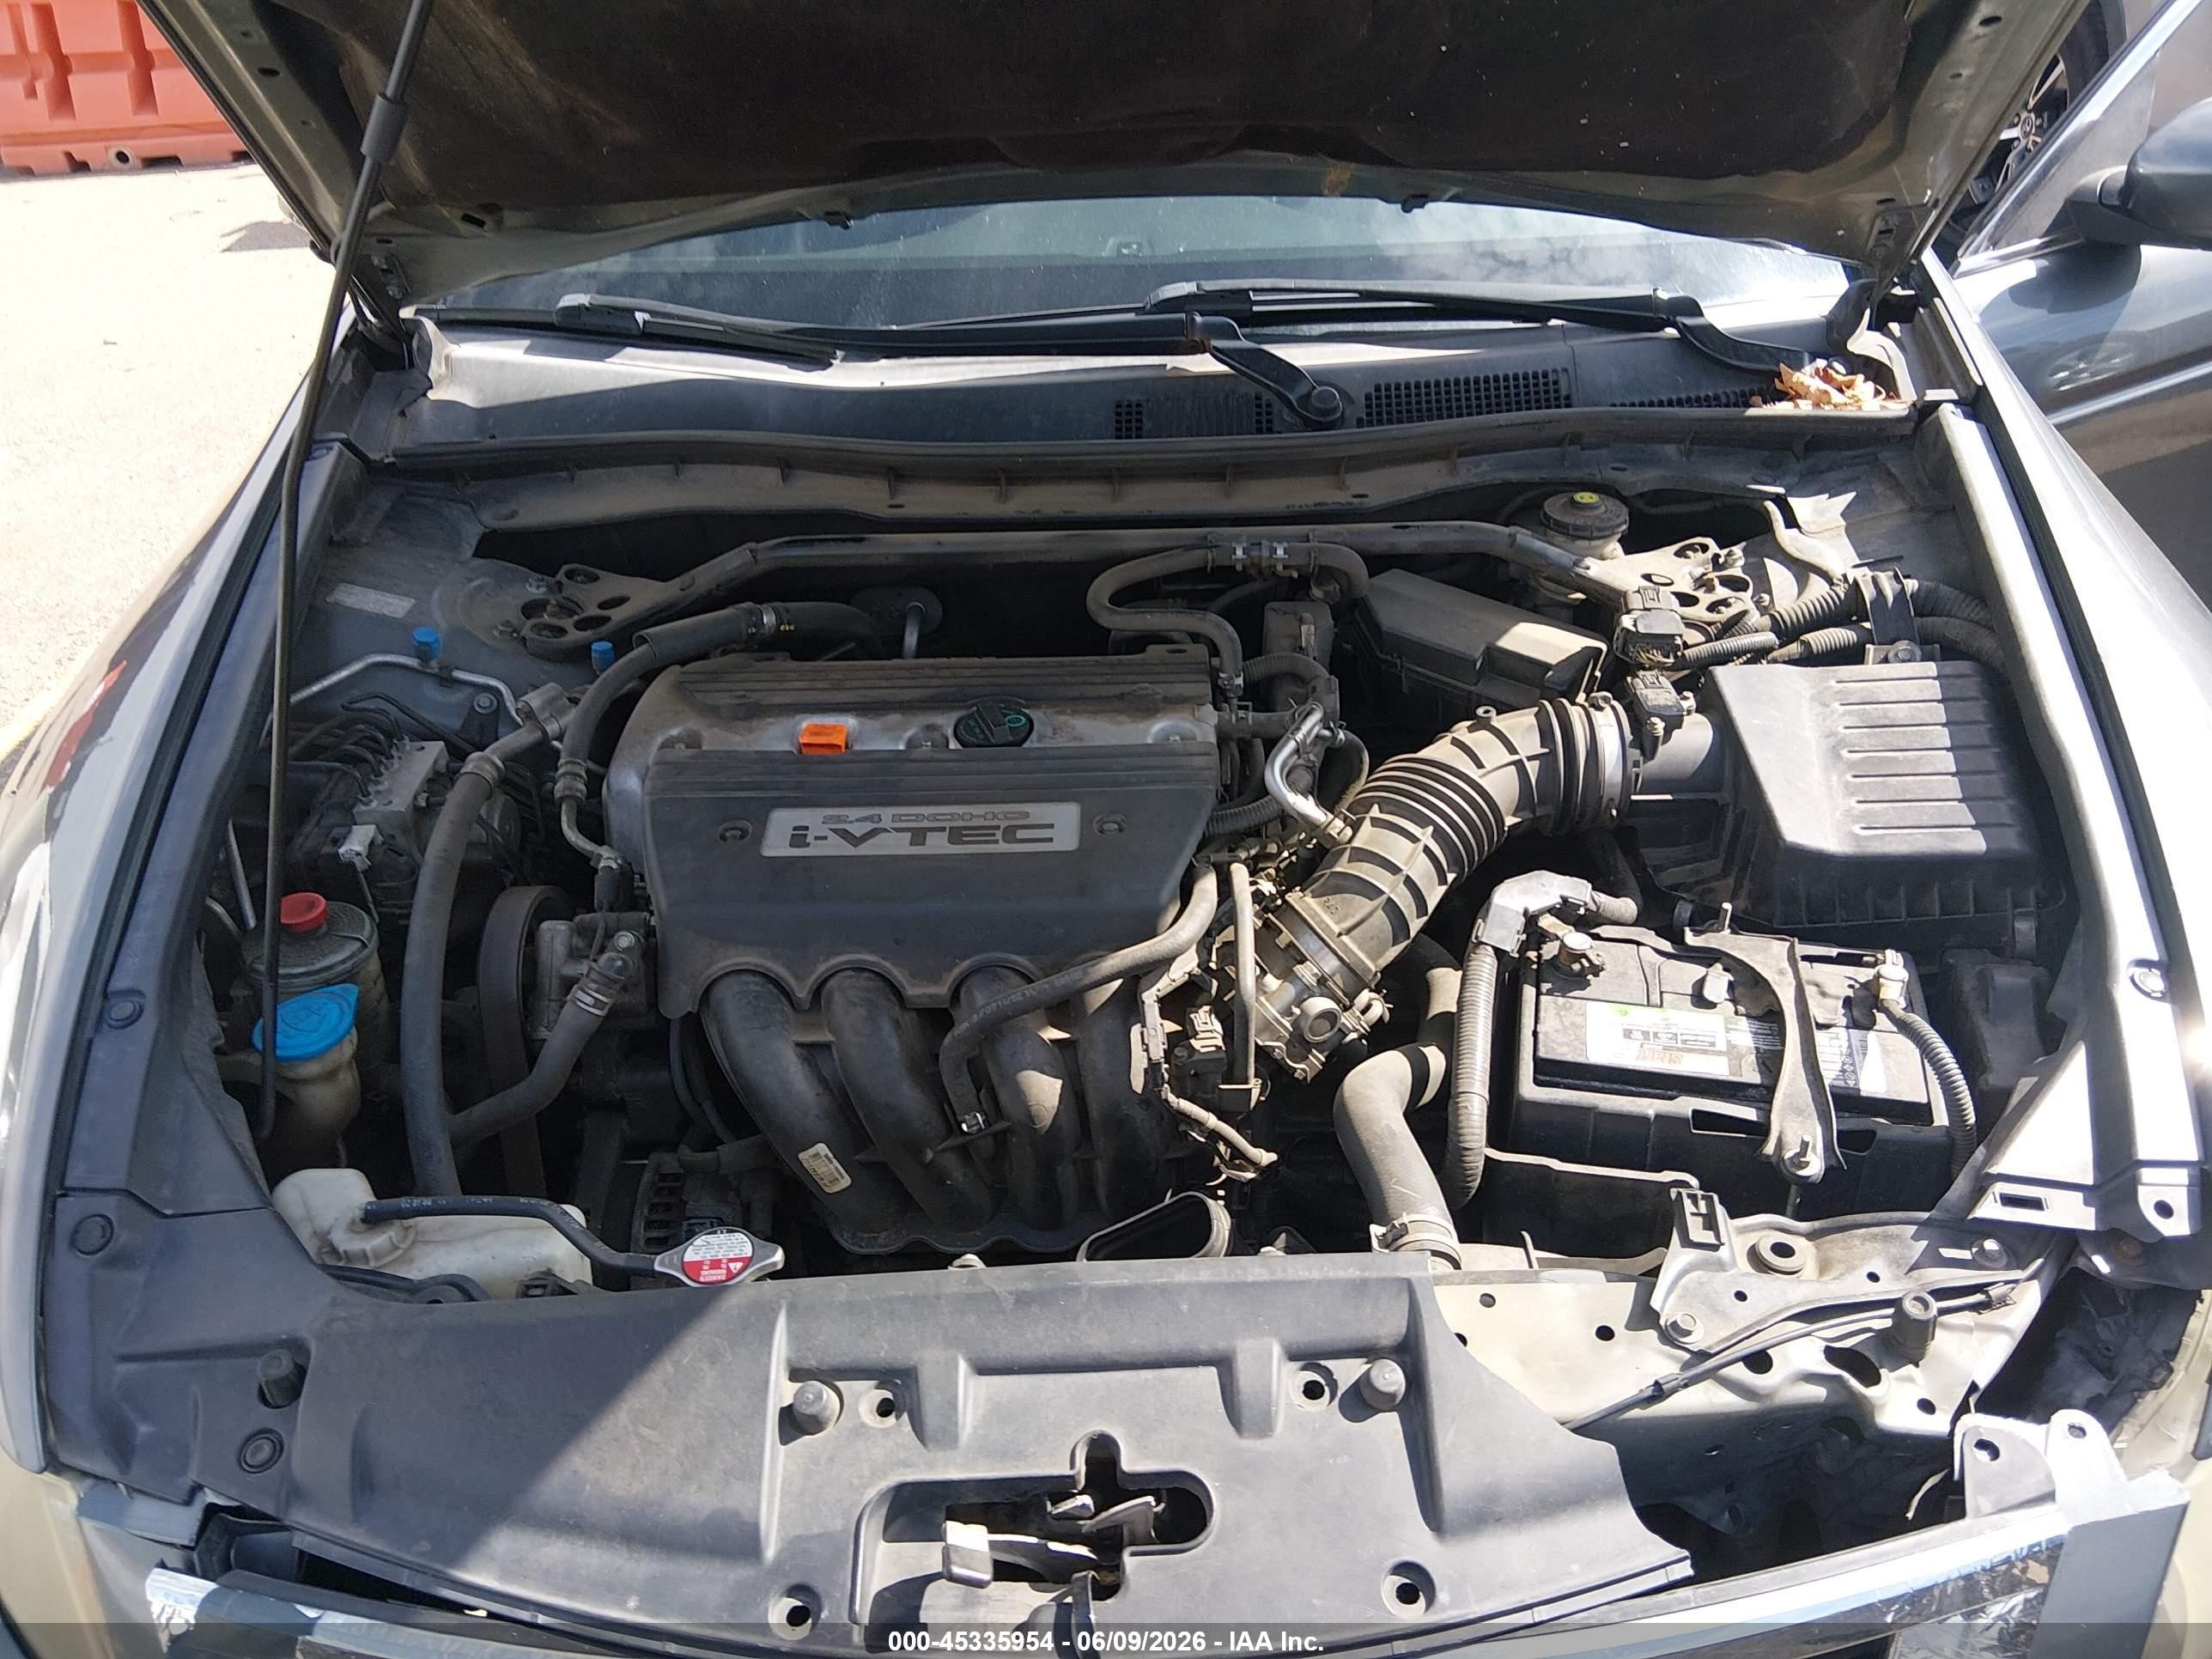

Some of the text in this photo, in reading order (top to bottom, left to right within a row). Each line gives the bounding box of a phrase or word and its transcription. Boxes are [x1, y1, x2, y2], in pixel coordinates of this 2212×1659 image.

[821, 810, 1030, 825] 2.4 DOHC
[788, 823, 1054, 849] i-VTEC
